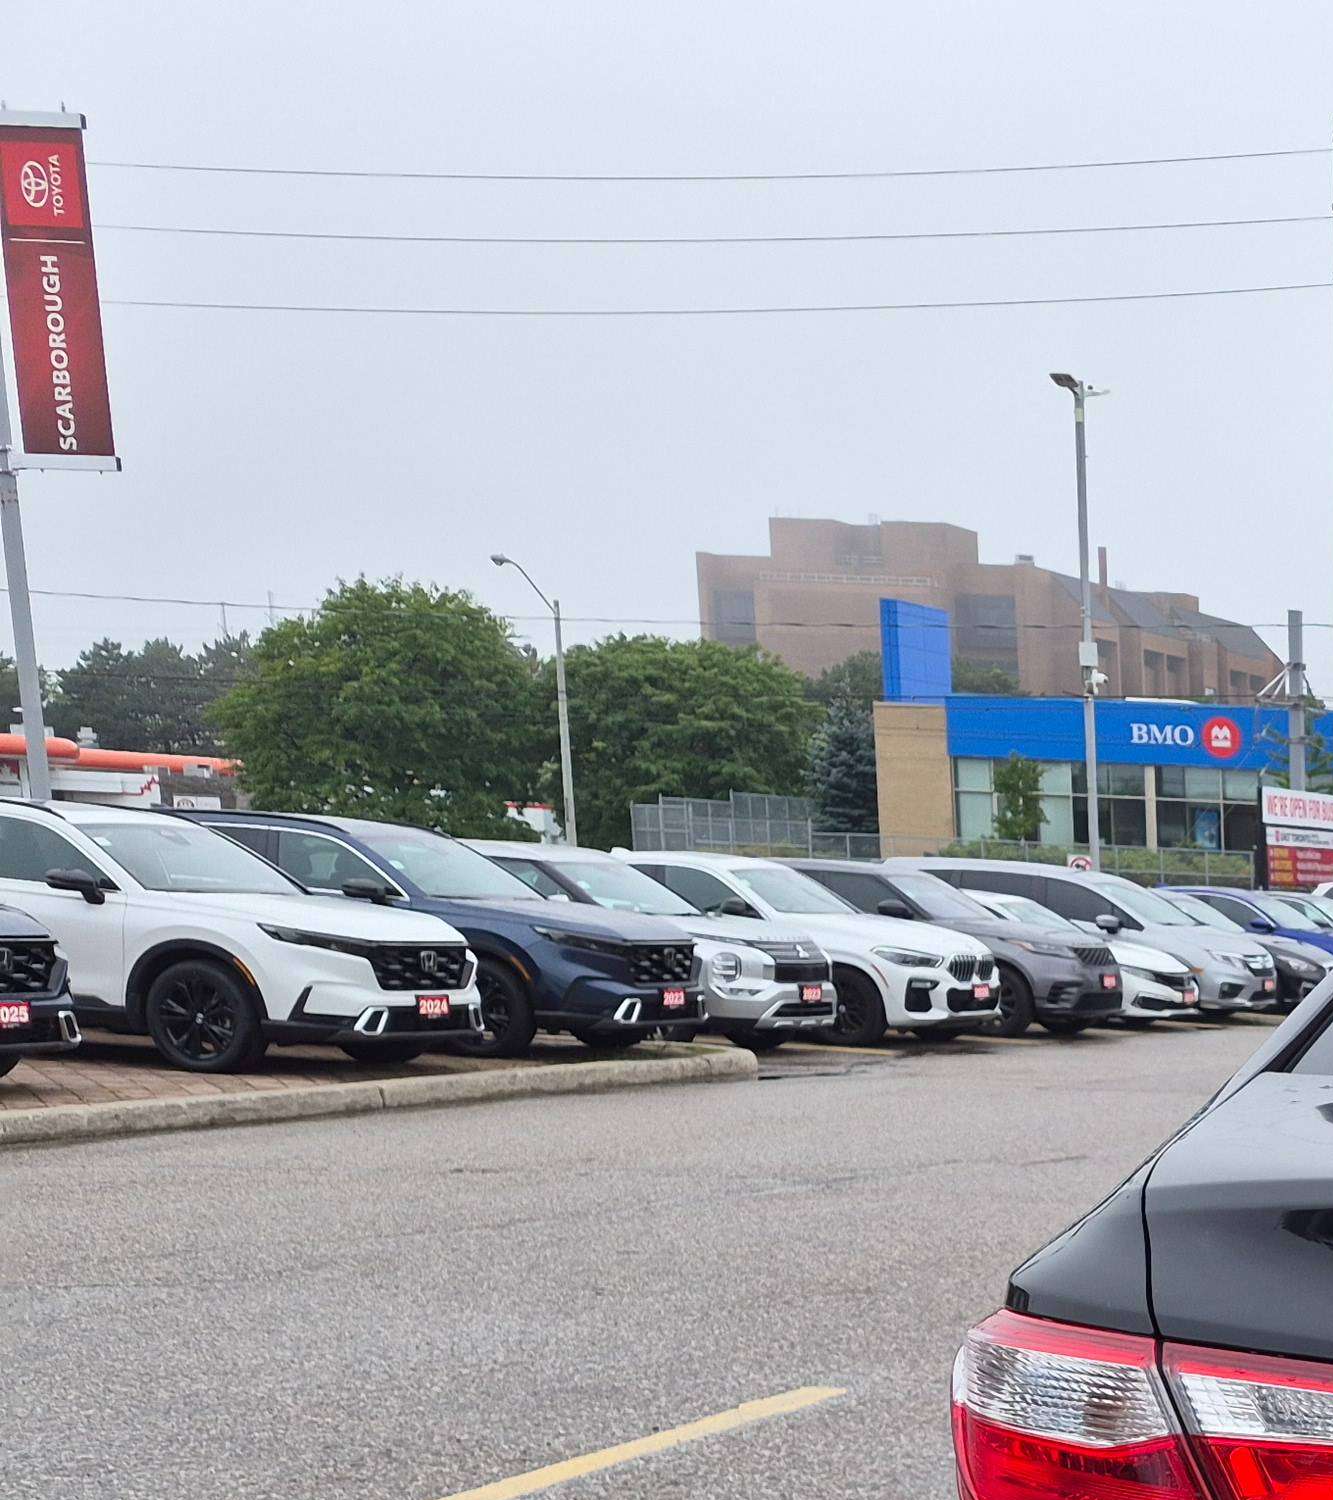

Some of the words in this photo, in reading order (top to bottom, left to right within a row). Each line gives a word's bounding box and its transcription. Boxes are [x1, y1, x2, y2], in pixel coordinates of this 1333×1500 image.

[48, 154, 65, 216] TOYOTA
[40, 255, 77, 451] SCARBOROUGH
[1129, 722, 1195, 746] BMO
[0, 1005, 29, 1023] 025
[419, 998, 449, 1015] 2024
